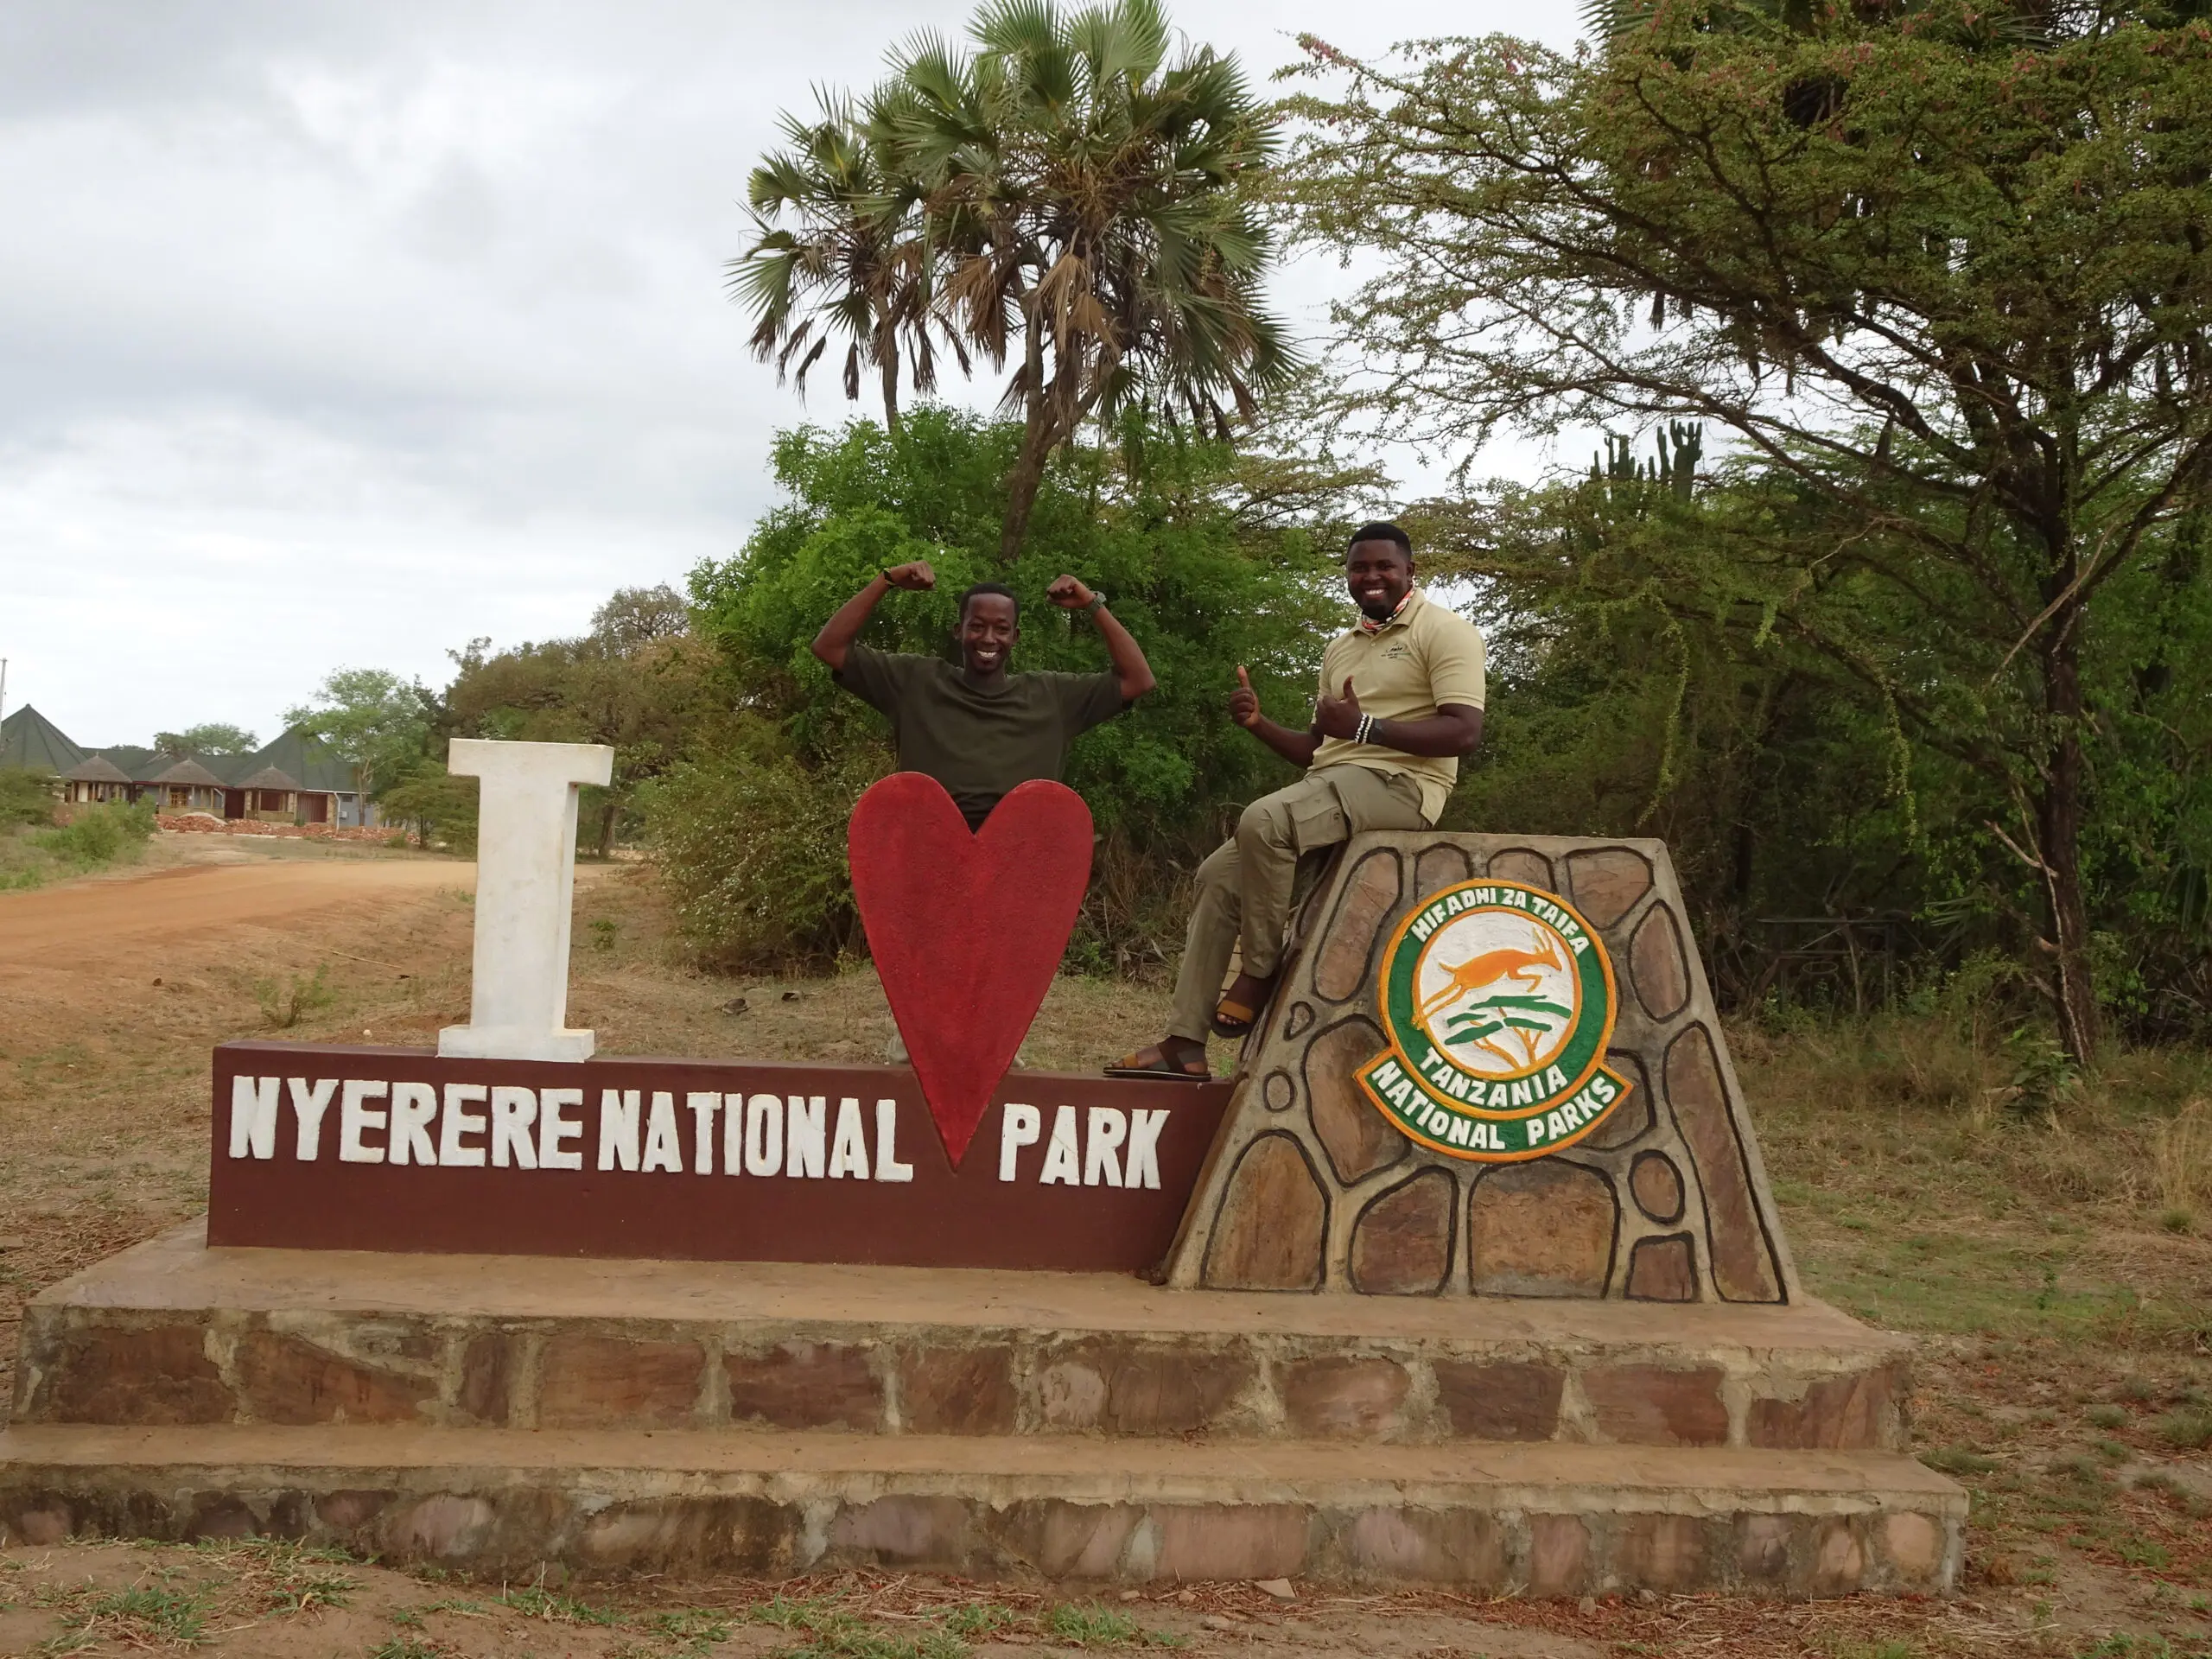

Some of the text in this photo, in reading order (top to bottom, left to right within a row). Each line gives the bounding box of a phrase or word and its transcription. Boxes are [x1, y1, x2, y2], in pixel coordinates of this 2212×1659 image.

[435, 738, 613, 1063] I
[1410, 887, 1590, 956] HIFADHI ZA TAIFA
[1371, 1060, 1617, 1150] NATIONAL PARKS
[1419, 1047, 1568, 1108] TANZANIA
[229, 1075, 1171, 1190] NYERERE NATIONAL PARK
